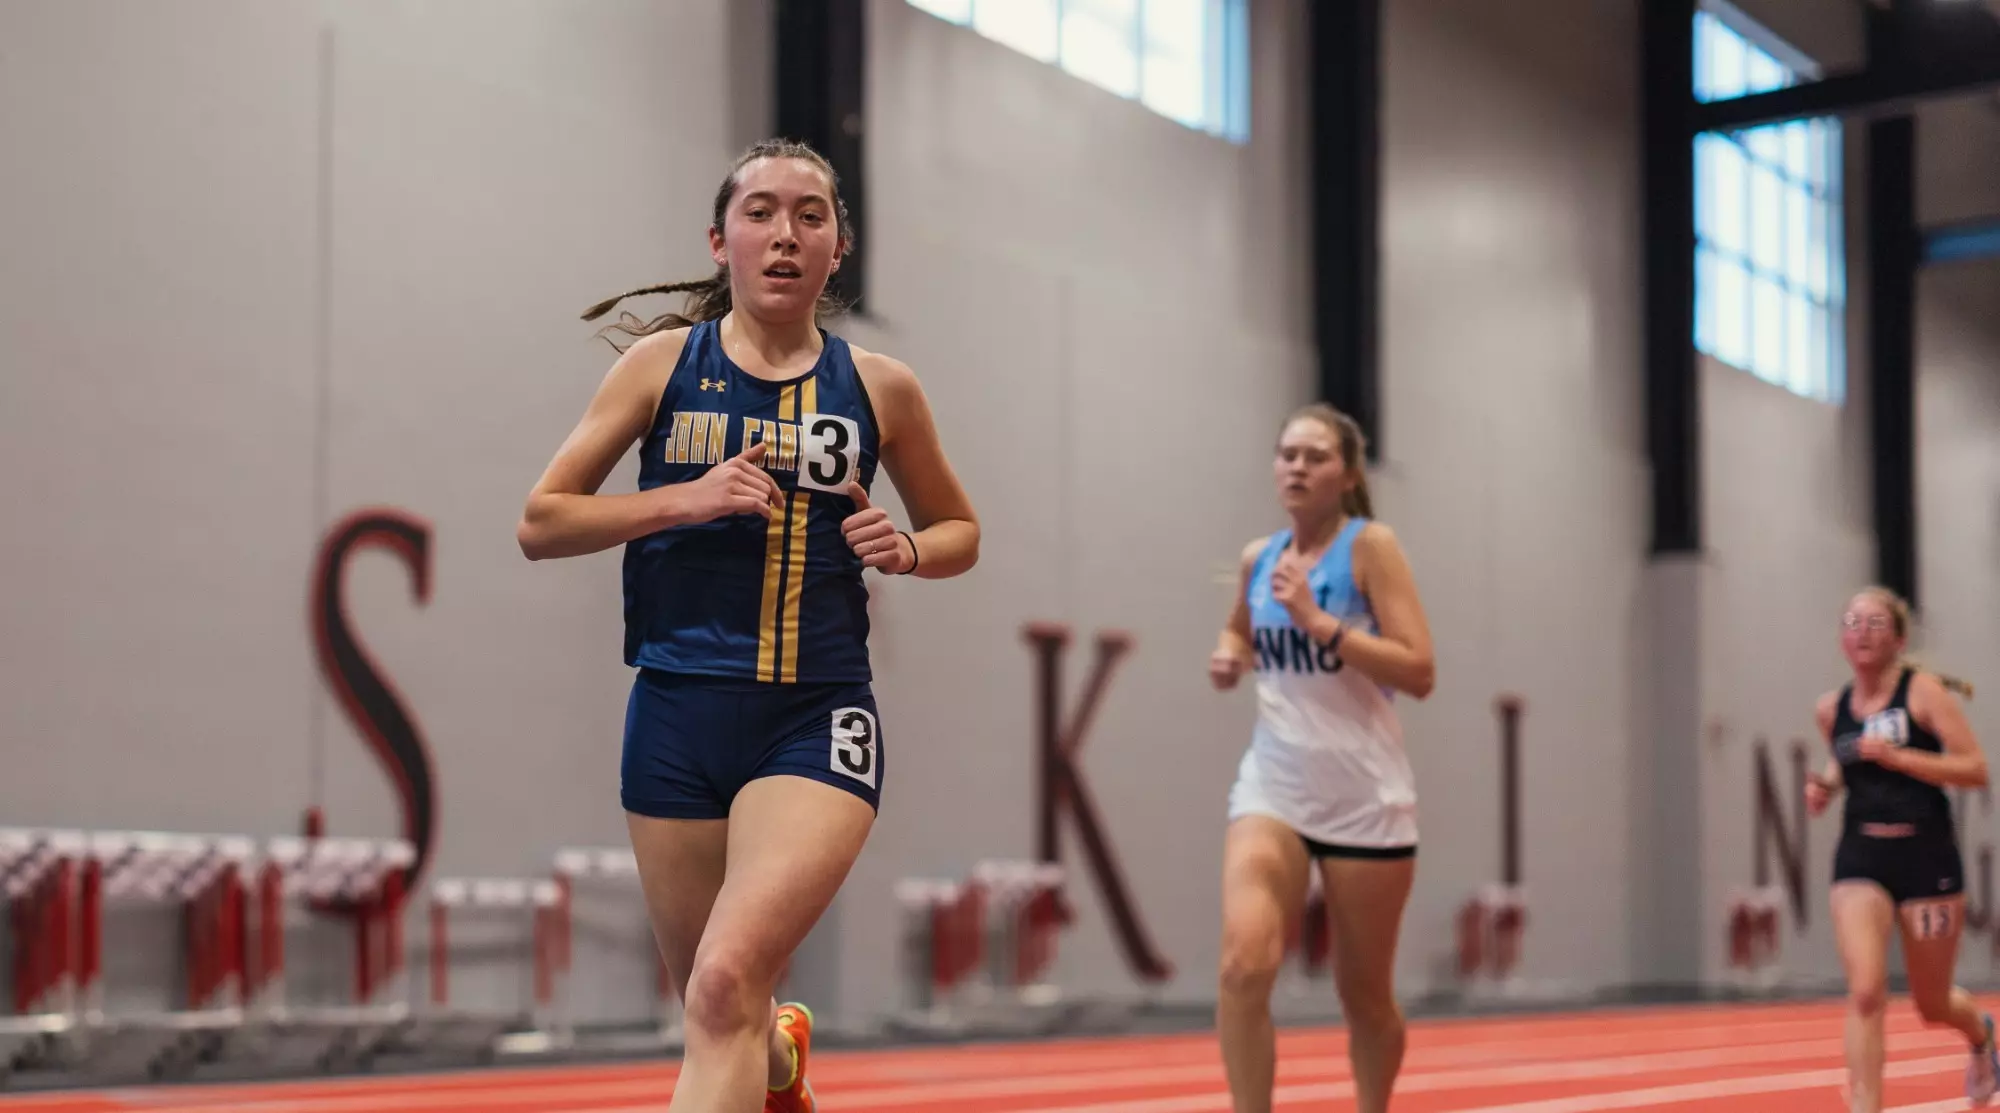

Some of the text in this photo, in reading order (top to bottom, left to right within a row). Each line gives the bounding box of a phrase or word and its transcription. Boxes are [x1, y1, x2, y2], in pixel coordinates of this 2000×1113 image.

[664, 411, 729, 465] JOHN
[808, 419, 849, 486] 3
[838, 711, 872, 776] 3
